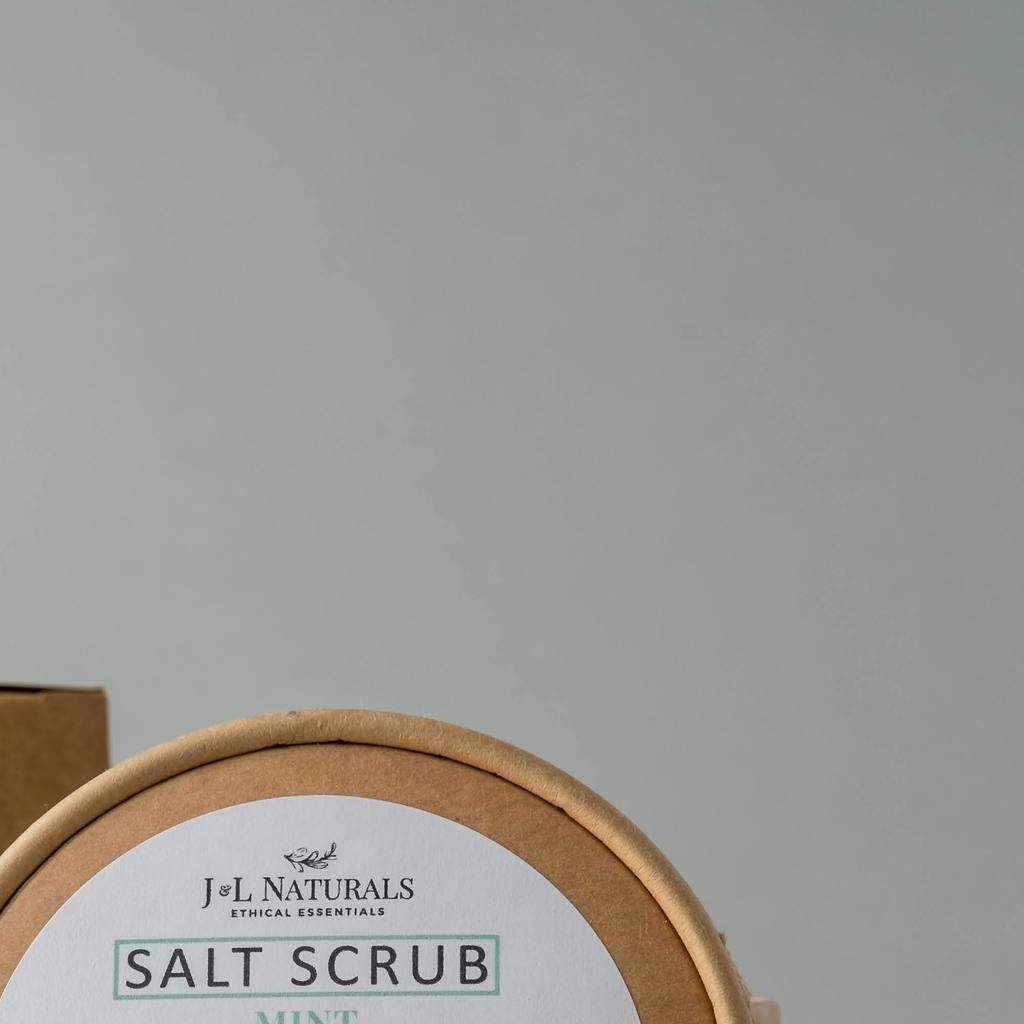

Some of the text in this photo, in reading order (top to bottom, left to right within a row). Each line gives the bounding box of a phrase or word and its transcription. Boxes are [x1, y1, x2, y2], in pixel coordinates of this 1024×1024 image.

[201, 876, 253, 909] J&L
[230, 907, 385, 918] ETHICAL ESSENTIALS
[125, 944, 489, 990] SALT SCRUB
